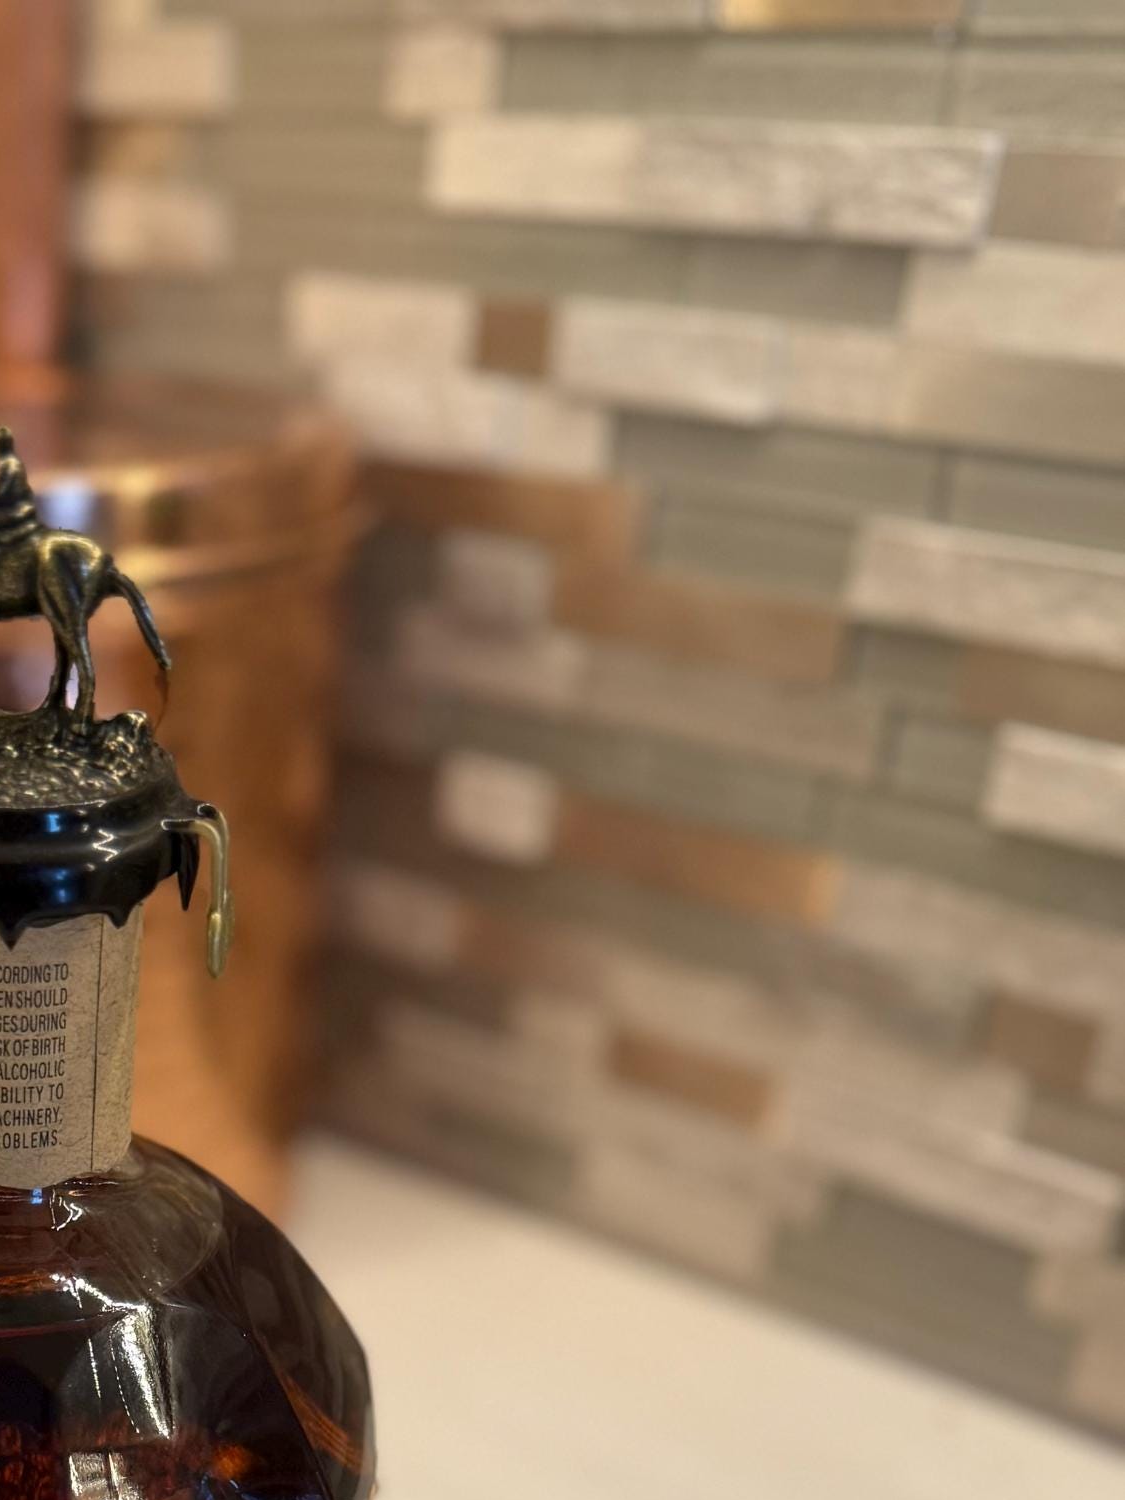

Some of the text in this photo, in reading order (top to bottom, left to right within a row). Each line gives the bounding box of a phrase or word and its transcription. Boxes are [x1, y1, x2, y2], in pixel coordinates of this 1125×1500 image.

[53, 962, 69, 982] TO
[15, 987, 68, 1009] SHOULD
[20, 1012, 67, 1033] DURING
[12, 1038, 30, 1058] OF
[31, 1035, 66, 1057] BIRTH
[48, 1083, 64, 1102] TO
